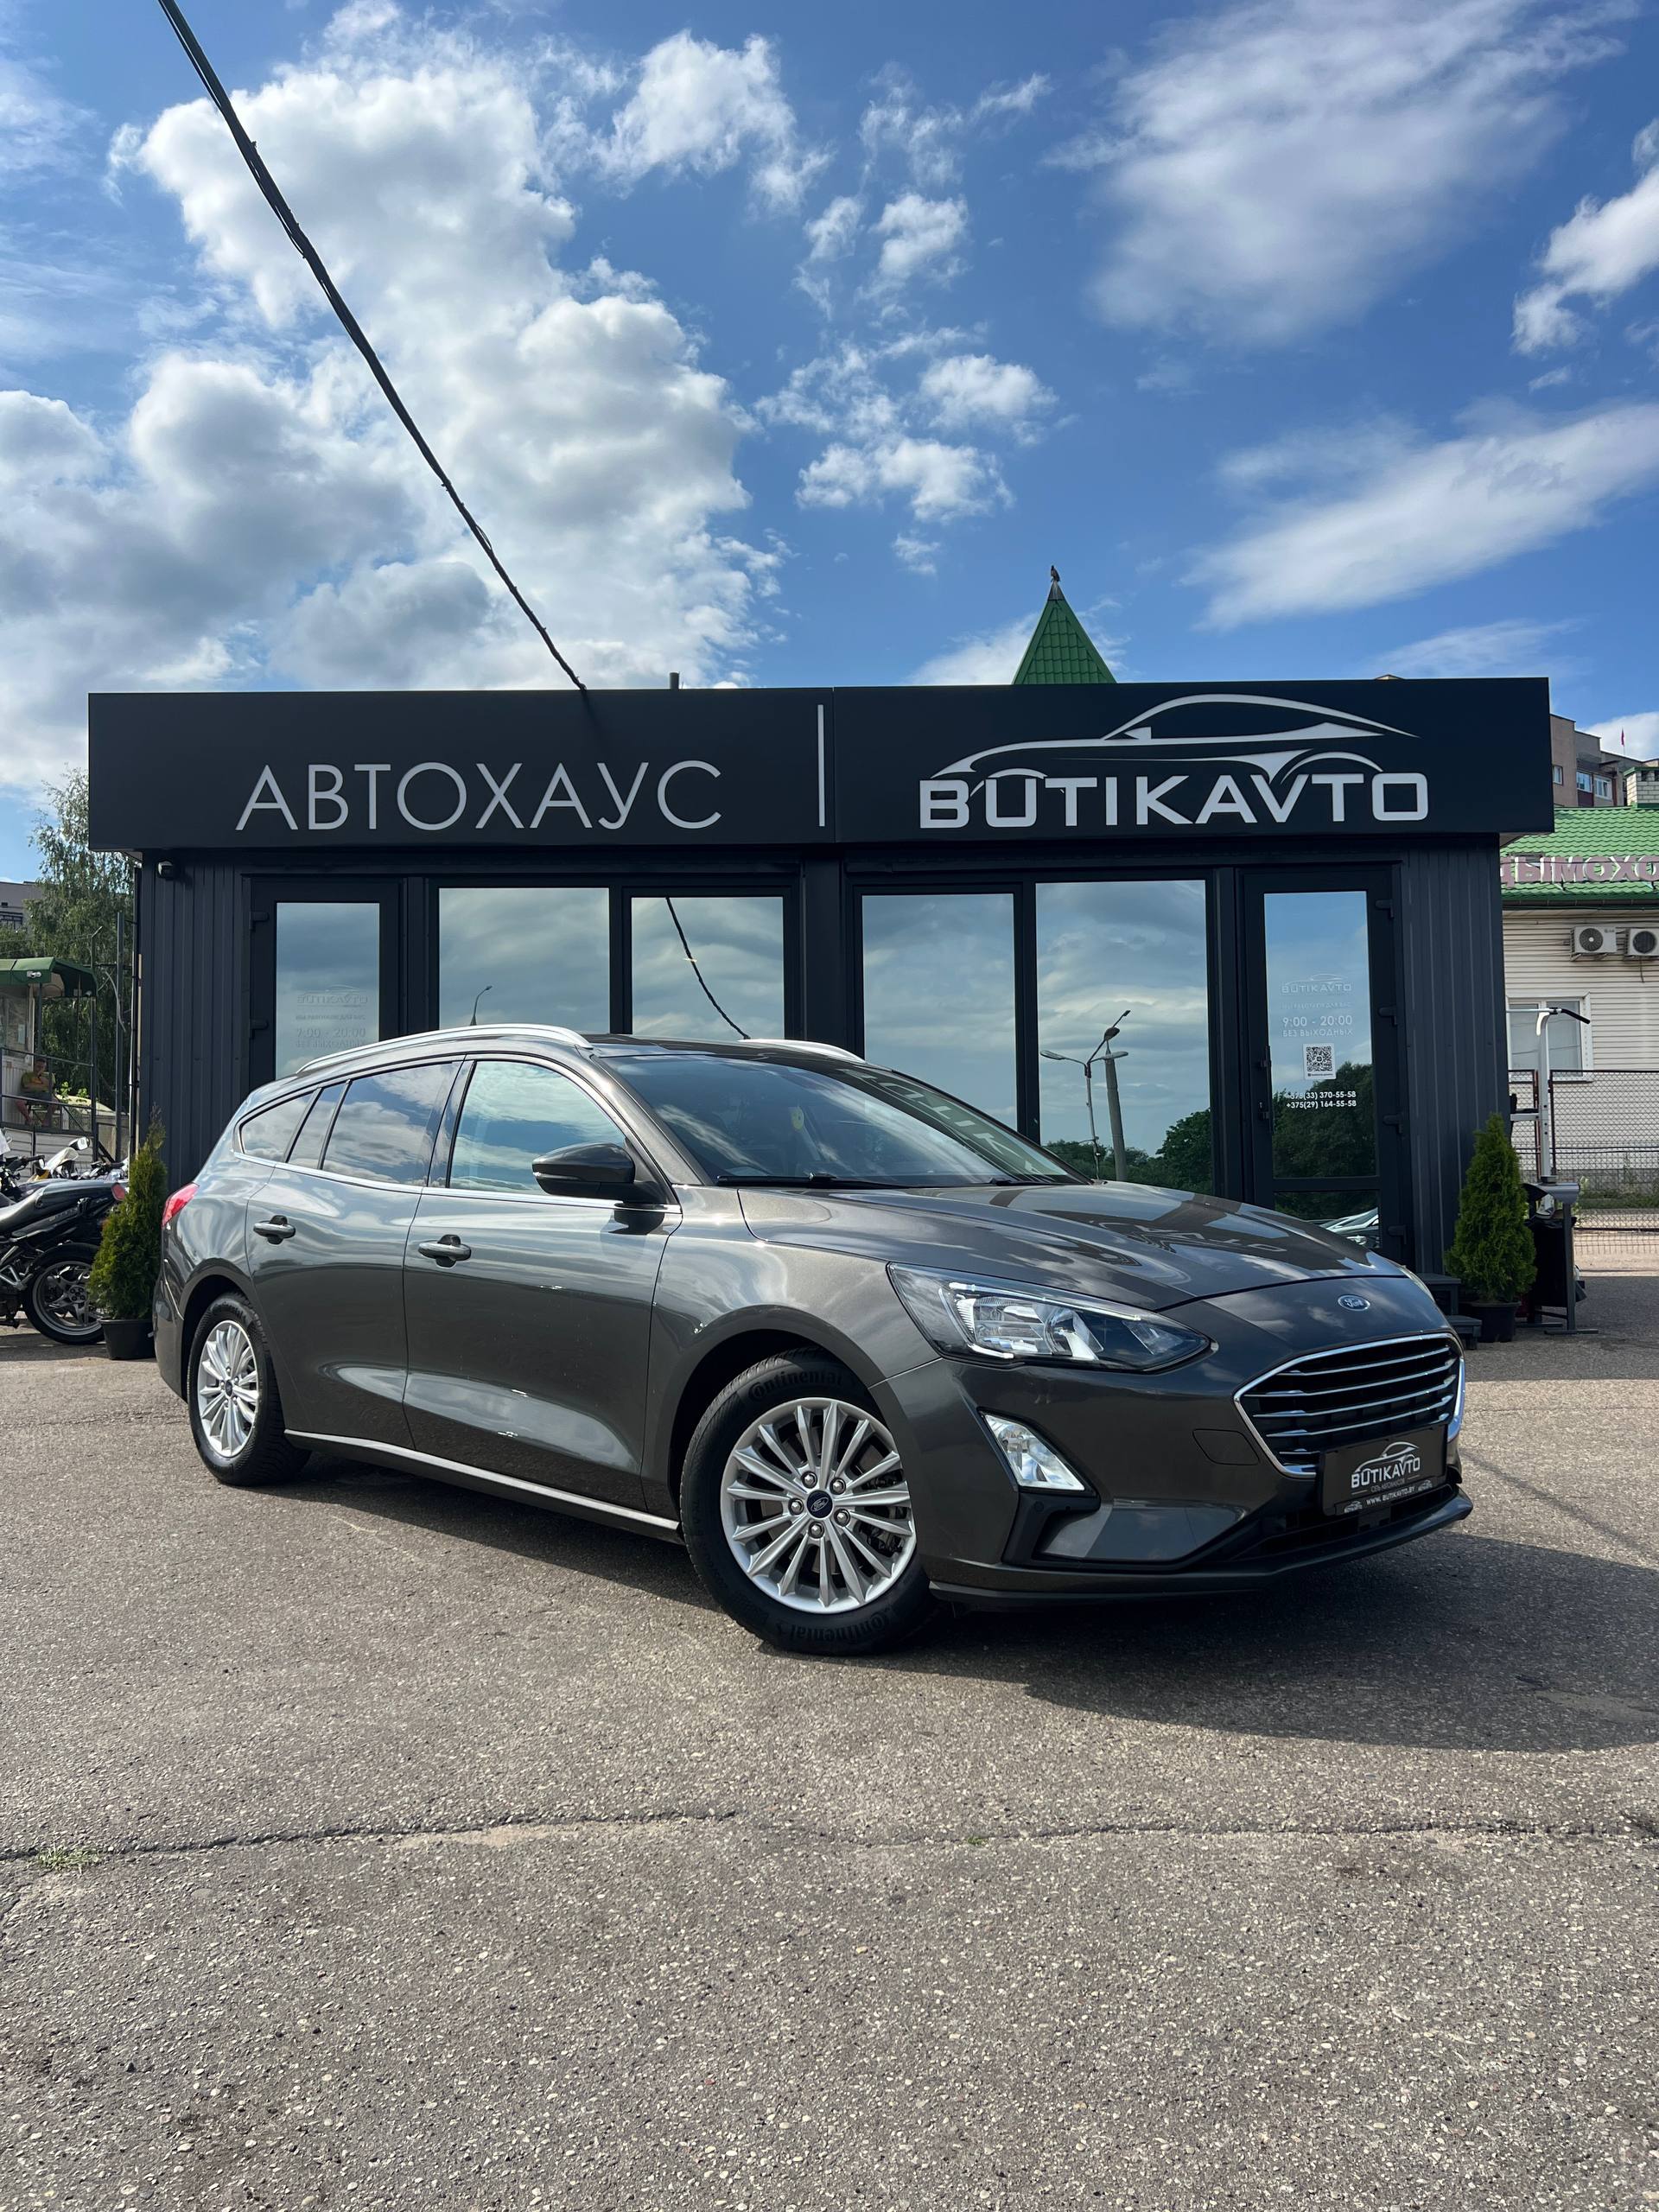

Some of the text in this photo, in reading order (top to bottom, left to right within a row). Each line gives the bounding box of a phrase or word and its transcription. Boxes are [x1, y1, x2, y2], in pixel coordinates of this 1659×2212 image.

[236, 760, 722, 832] АВТОХАУС
[919, 772, 1428, 829] BUTIKAVTO
[1282, 1016, 1307, 1028] 9:00
[1319, 1014, 1353, 1027] 20:00
[1300, 1028, 1353, 1037] ВЫХОДНЫХ
[1286, 1101, 1319, 1110] +375(29)
[1351, 1458, 1421, 1489] BUTIKAVTO
